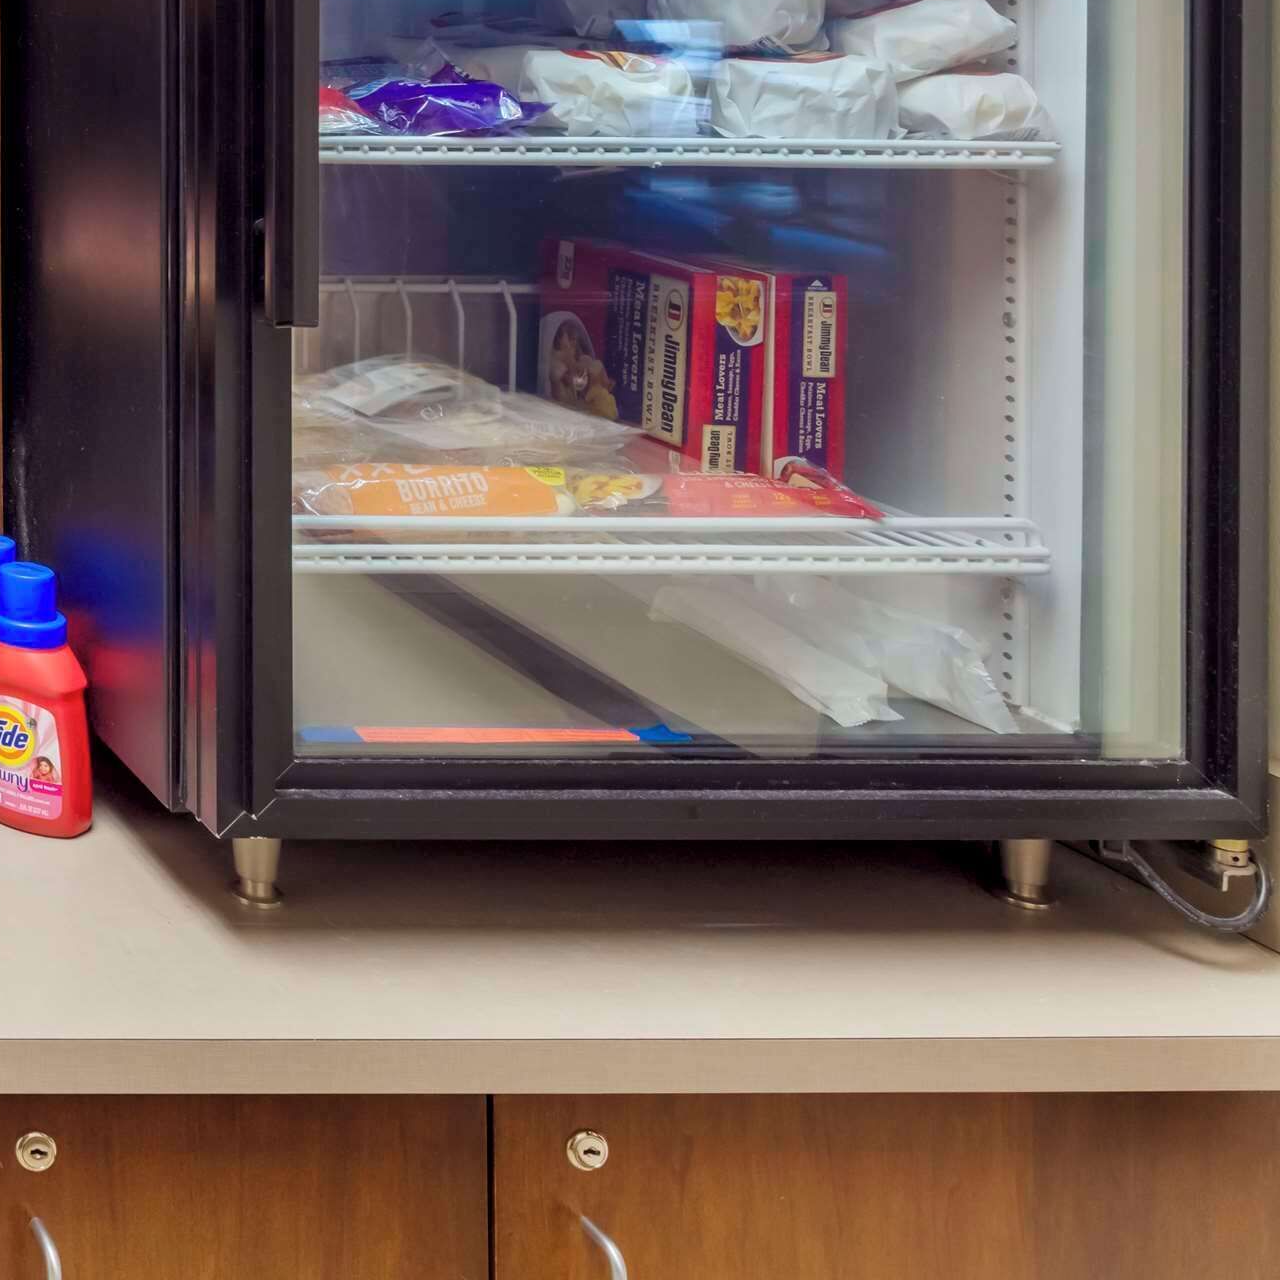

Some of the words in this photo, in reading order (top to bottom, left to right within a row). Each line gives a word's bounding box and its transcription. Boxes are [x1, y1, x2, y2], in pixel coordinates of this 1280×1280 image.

[647, 283, 660, 374] BREAKFAST
[806, 295, 815, 346] BREAKFAST
[818, 320, 833, 353] Jimmy
[630, 333, 643, 392] Lovers
[662, 334, 681, 392] Jimmy
[716, 353, 727, 389] Lovers
[818, 351, 832, 373] Dean
[645, 382, 655, 426] BOWL
[661, 390, 678, 434] Dean
[715, 389, 725, 421] Meat
[816, 382, 827, 414] Meat
[814, 412, 826, 449] Lovers
[395, 472, 490, 503] BURRITO
[449, 494, 487, 510] CHEESE
